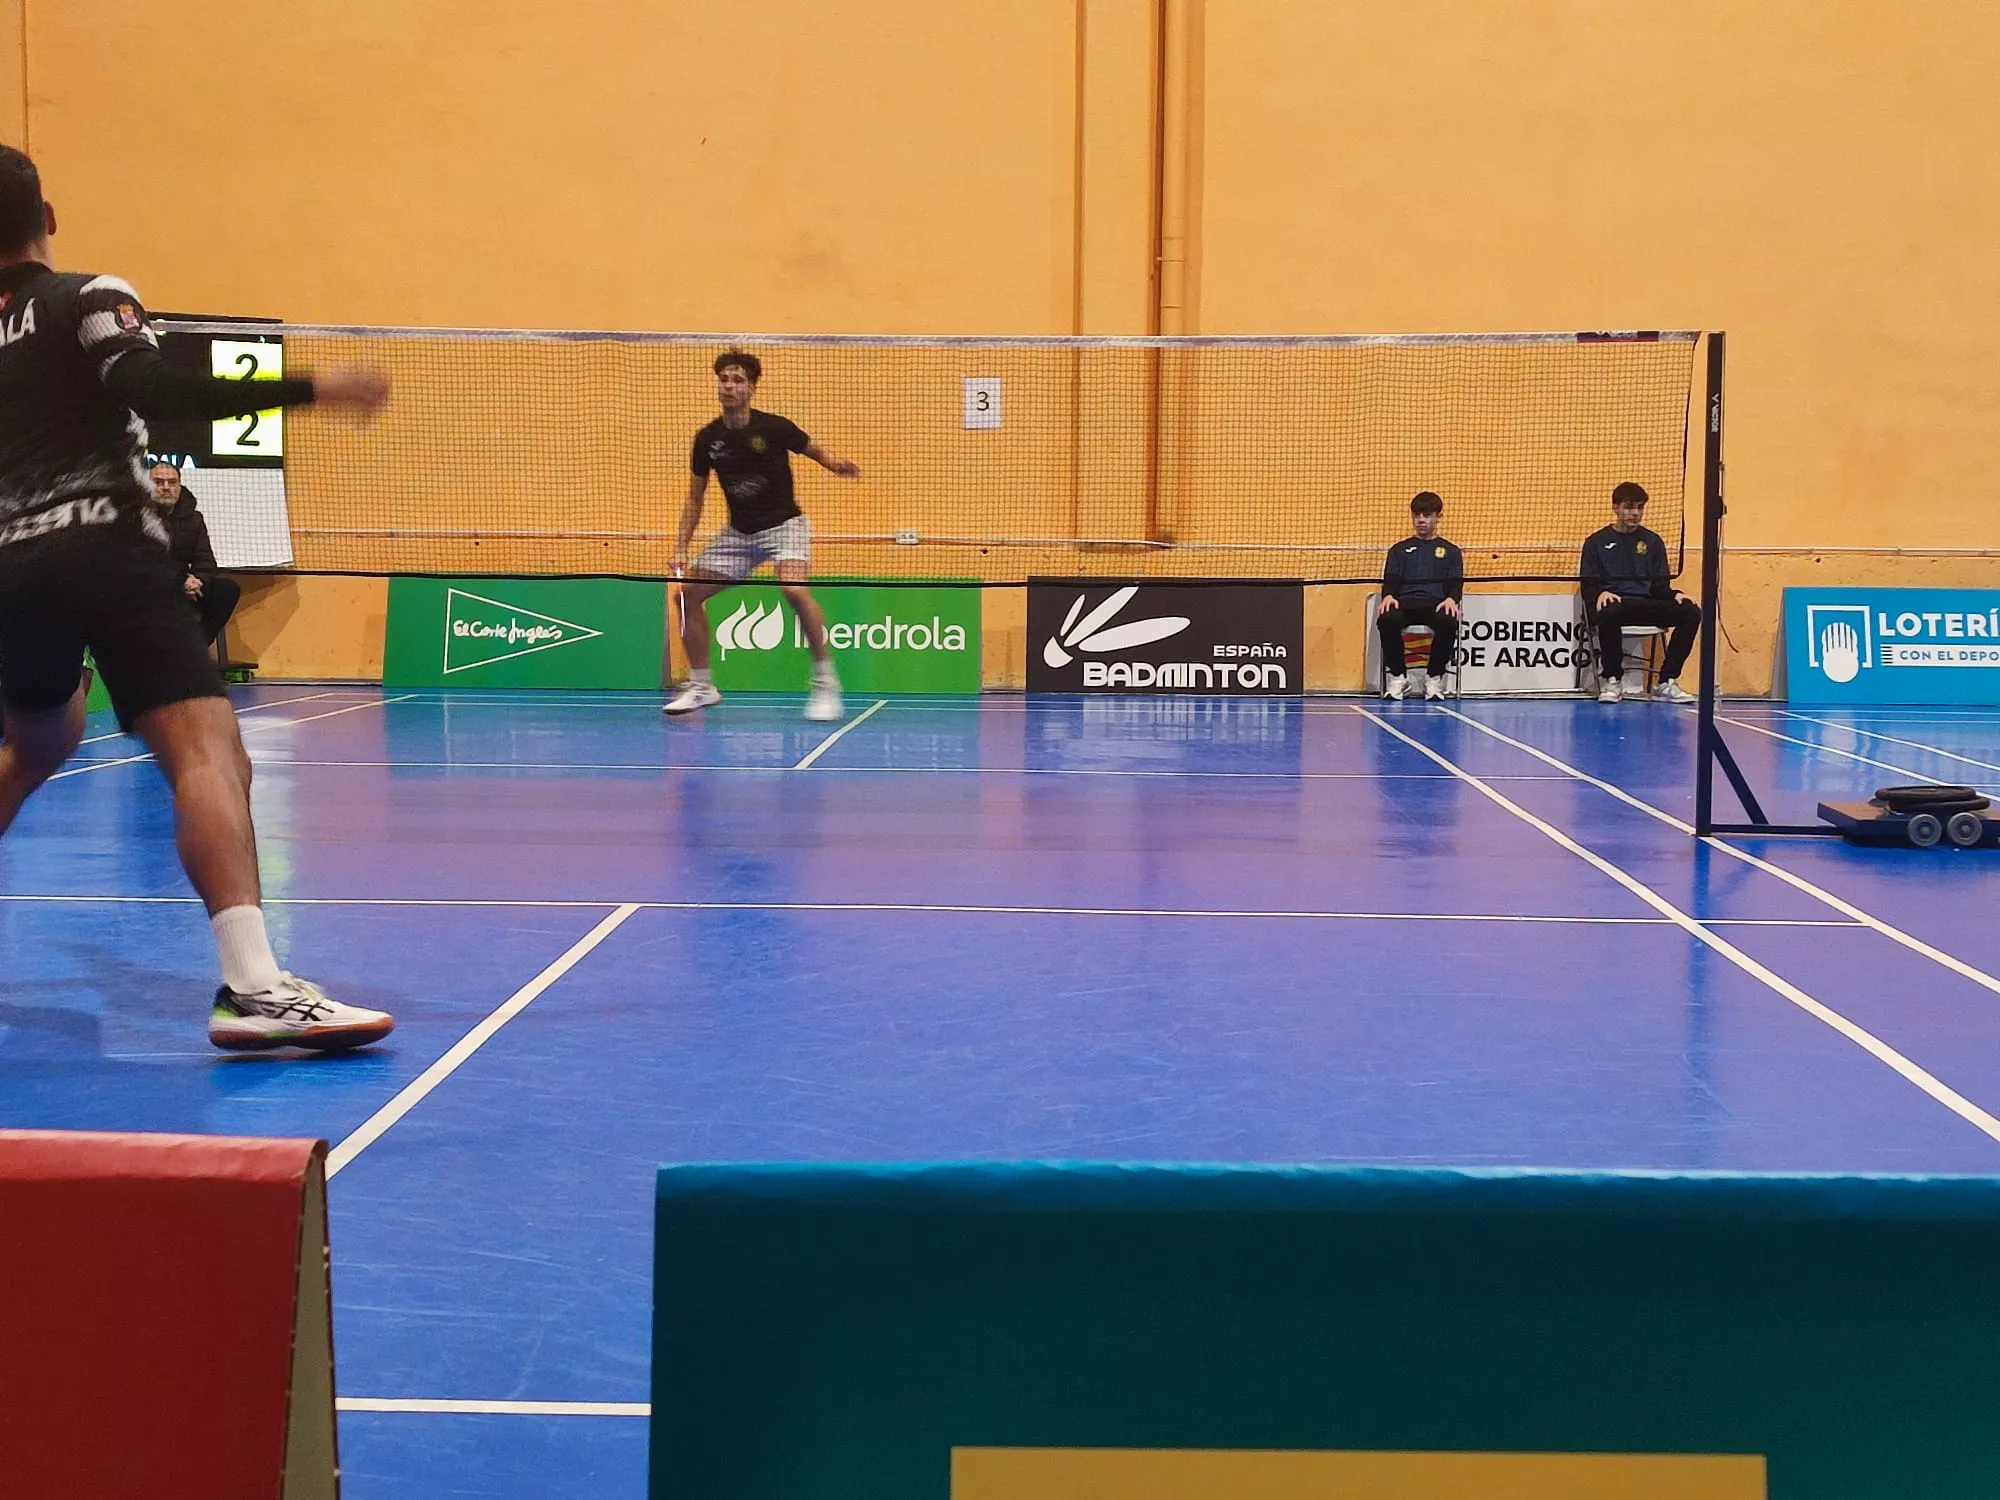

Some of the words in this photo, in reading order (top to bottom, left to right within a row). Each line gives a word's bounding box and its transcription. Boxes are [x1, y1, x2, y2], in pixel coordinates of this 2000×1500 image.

[236, 354, 259, 383] 2
[976, 391, 990, 411] 3
[237, 408, 260, 446] 2
[453, 620, 470, 637] El
[470, 621, 507, 638] Corte
[1213, 642, 1287, 658] ESPAÑA
[1451, 647, 1485, 667] DE
[1899, 650, 1931, 661] CON
[1937, 651, 1954, 661] EL
[1083, 662, 1287, 689] BADMINTON
